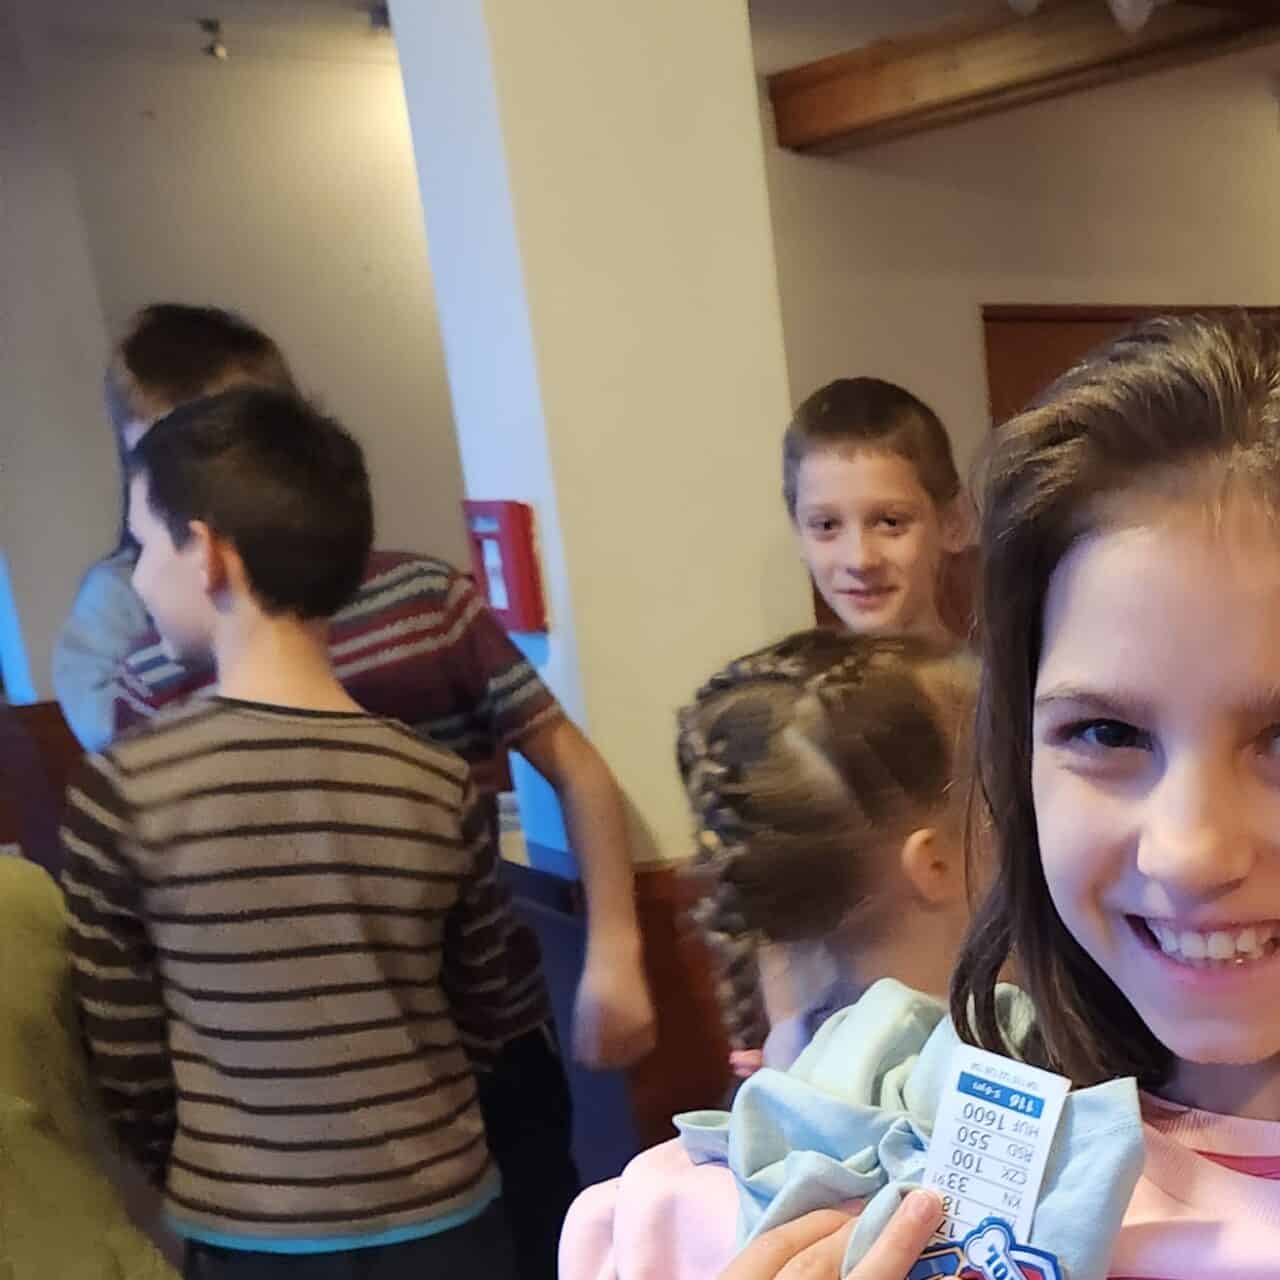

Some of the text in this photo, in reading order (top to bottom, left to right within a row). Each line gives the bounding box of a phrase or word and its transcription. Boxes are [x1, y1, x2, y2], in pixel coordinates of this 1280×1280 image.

[963, 1102, 1005, 1131] 1600
[958, 1126, 1034, 1163] RSD 550
[951, 1149, 1028, 1186] CZK 100
